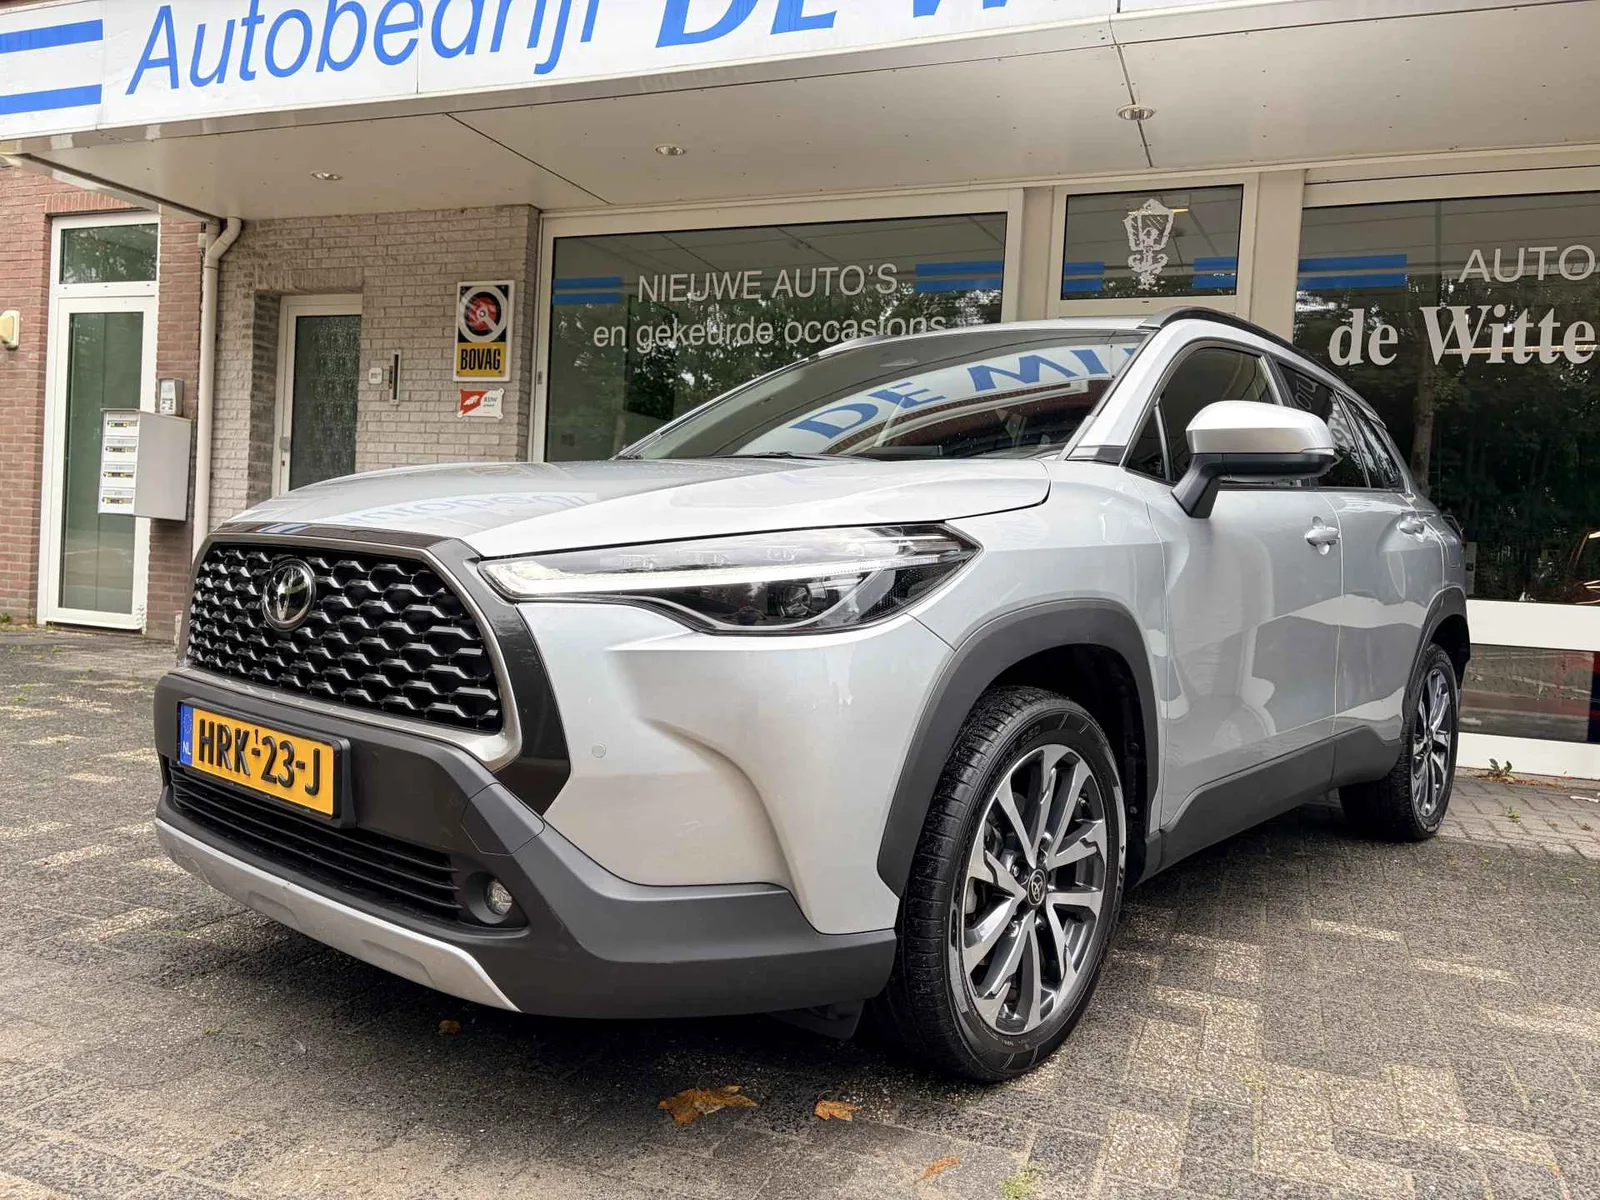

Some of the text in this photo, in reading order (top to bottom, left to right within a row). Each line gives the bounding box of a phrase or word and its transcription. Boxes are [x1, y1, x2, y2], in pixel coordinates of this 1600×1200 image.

[638, 262, 899, 303] NIEUWE AUTO'S
[1458, 244, 1596, 284] AUTO
[593, 314, 947, 353] en gekeurde occasions
[1328, 304, 1597, 366] de Witte
[460, 348, 501, 371] BOVAG
[183, 718, 321, 796] NL HRK-23-J
